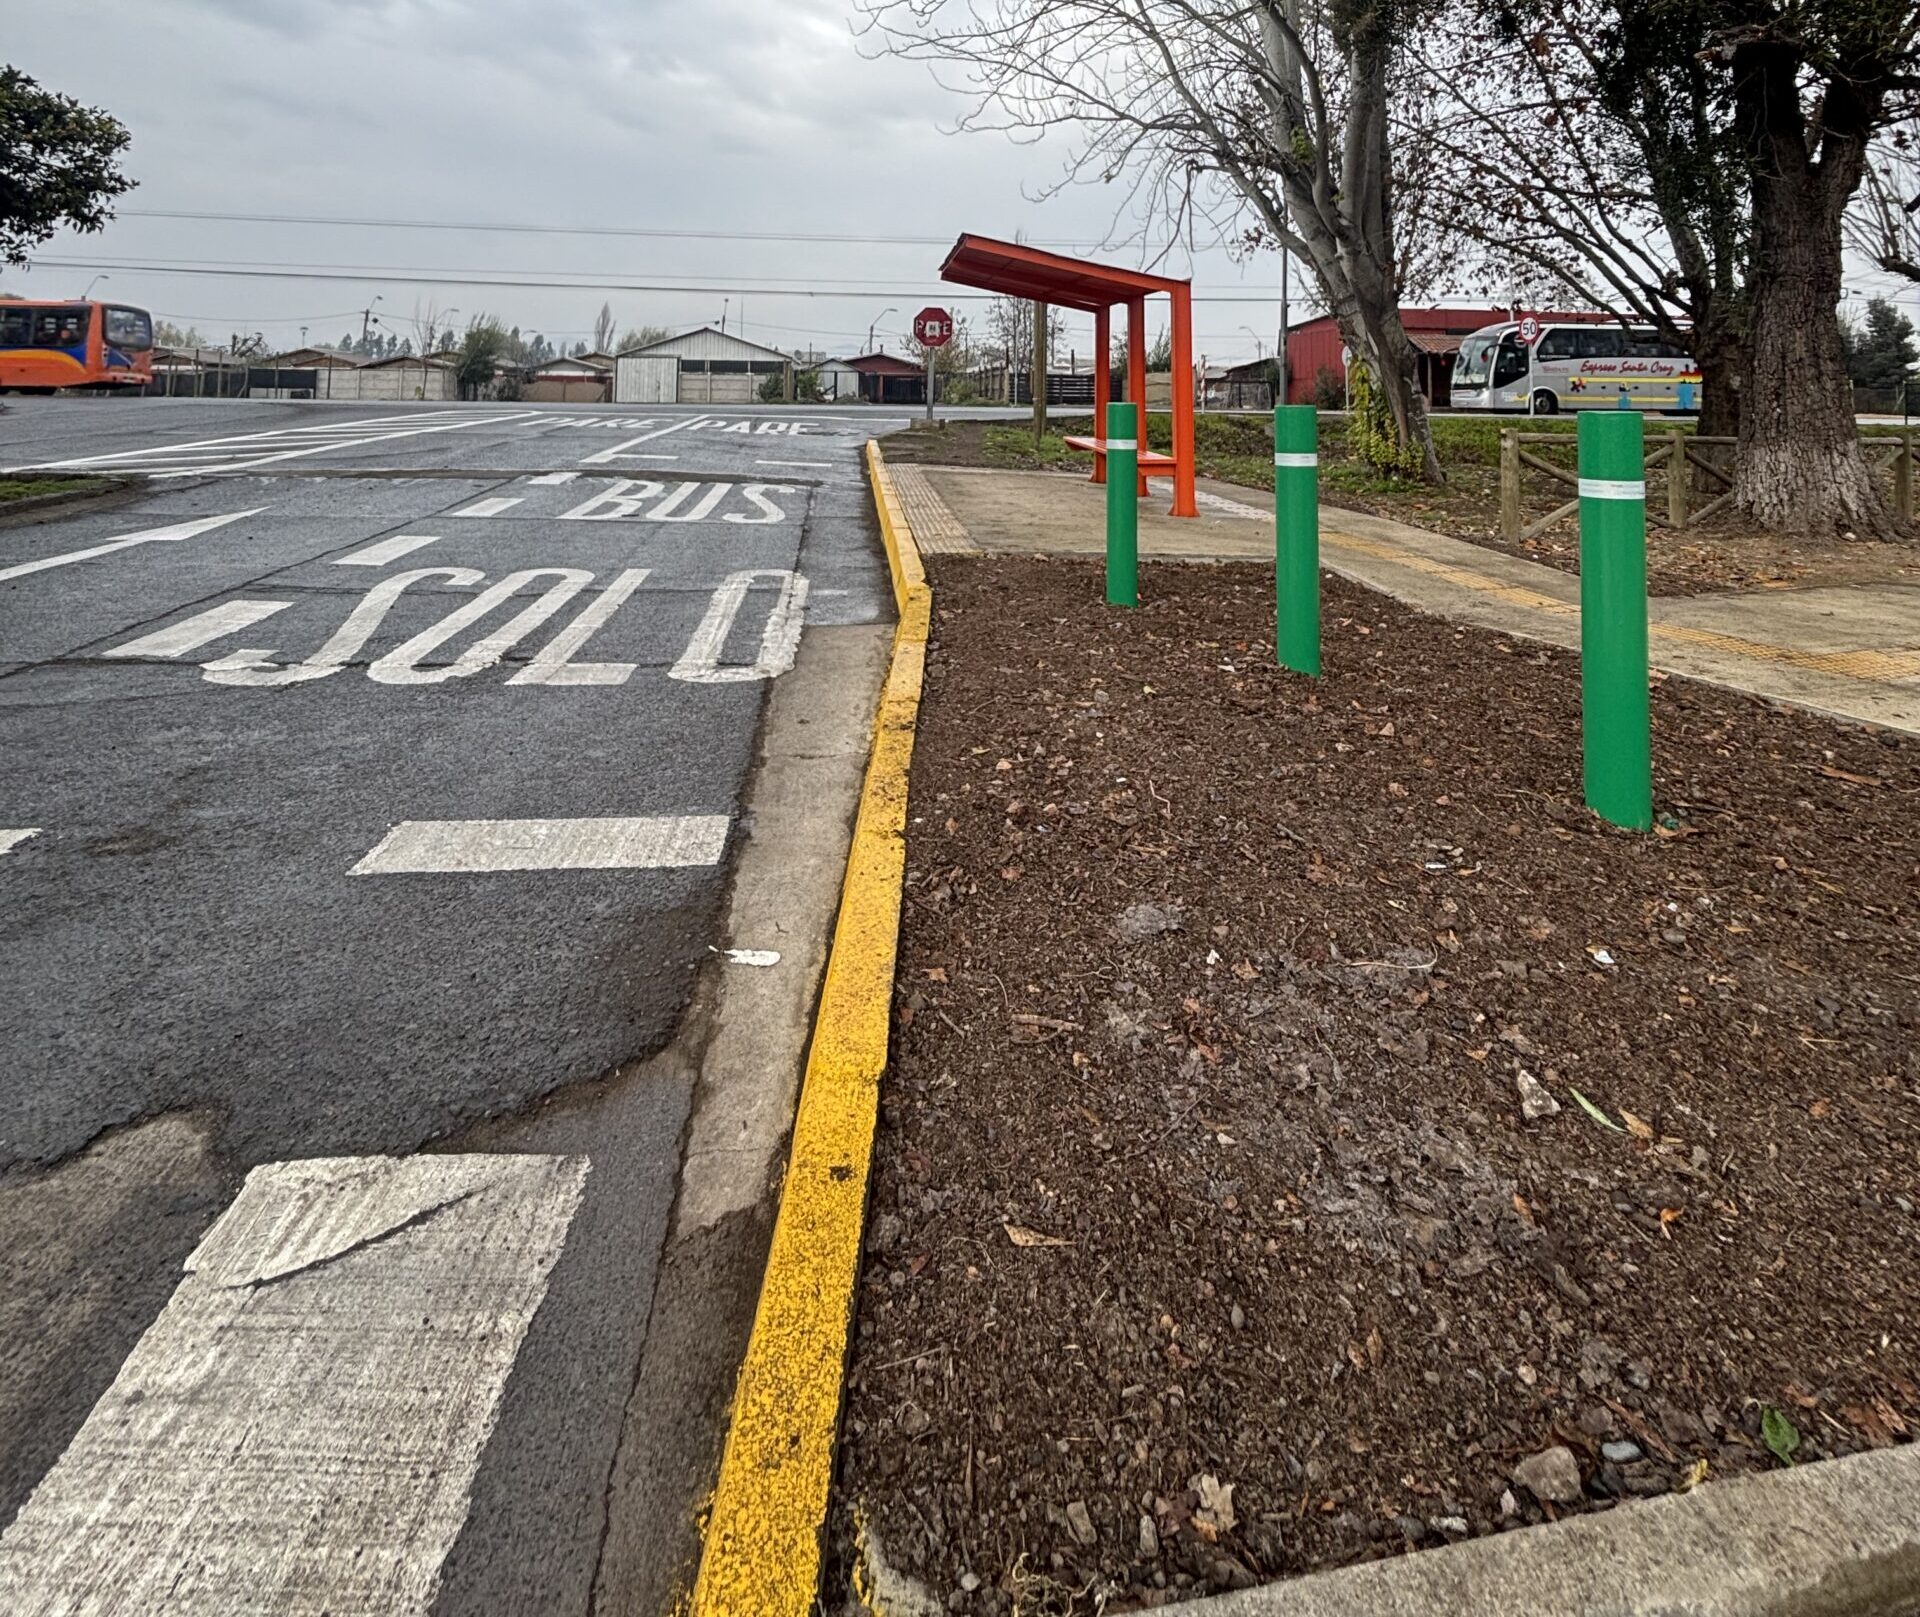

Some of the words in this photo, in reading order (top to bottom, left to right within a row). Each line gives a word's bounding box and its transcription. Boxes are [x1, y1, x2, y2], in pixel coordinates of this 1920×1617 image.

[915, 319, 951, 336] PE
[1522, 321, 1537, 336] 50
[1580, 360, 1617, 375] Expreso
[1619, 360, 1648, 373] Santa
[1650, 361, 1674, 376] Cruz
[519, 416, 674, 429] PARE
[686, 419, 821, 436] PARE
[555, 478, 796, 524] BUS
[200, 567, 810, 686] SOLO
